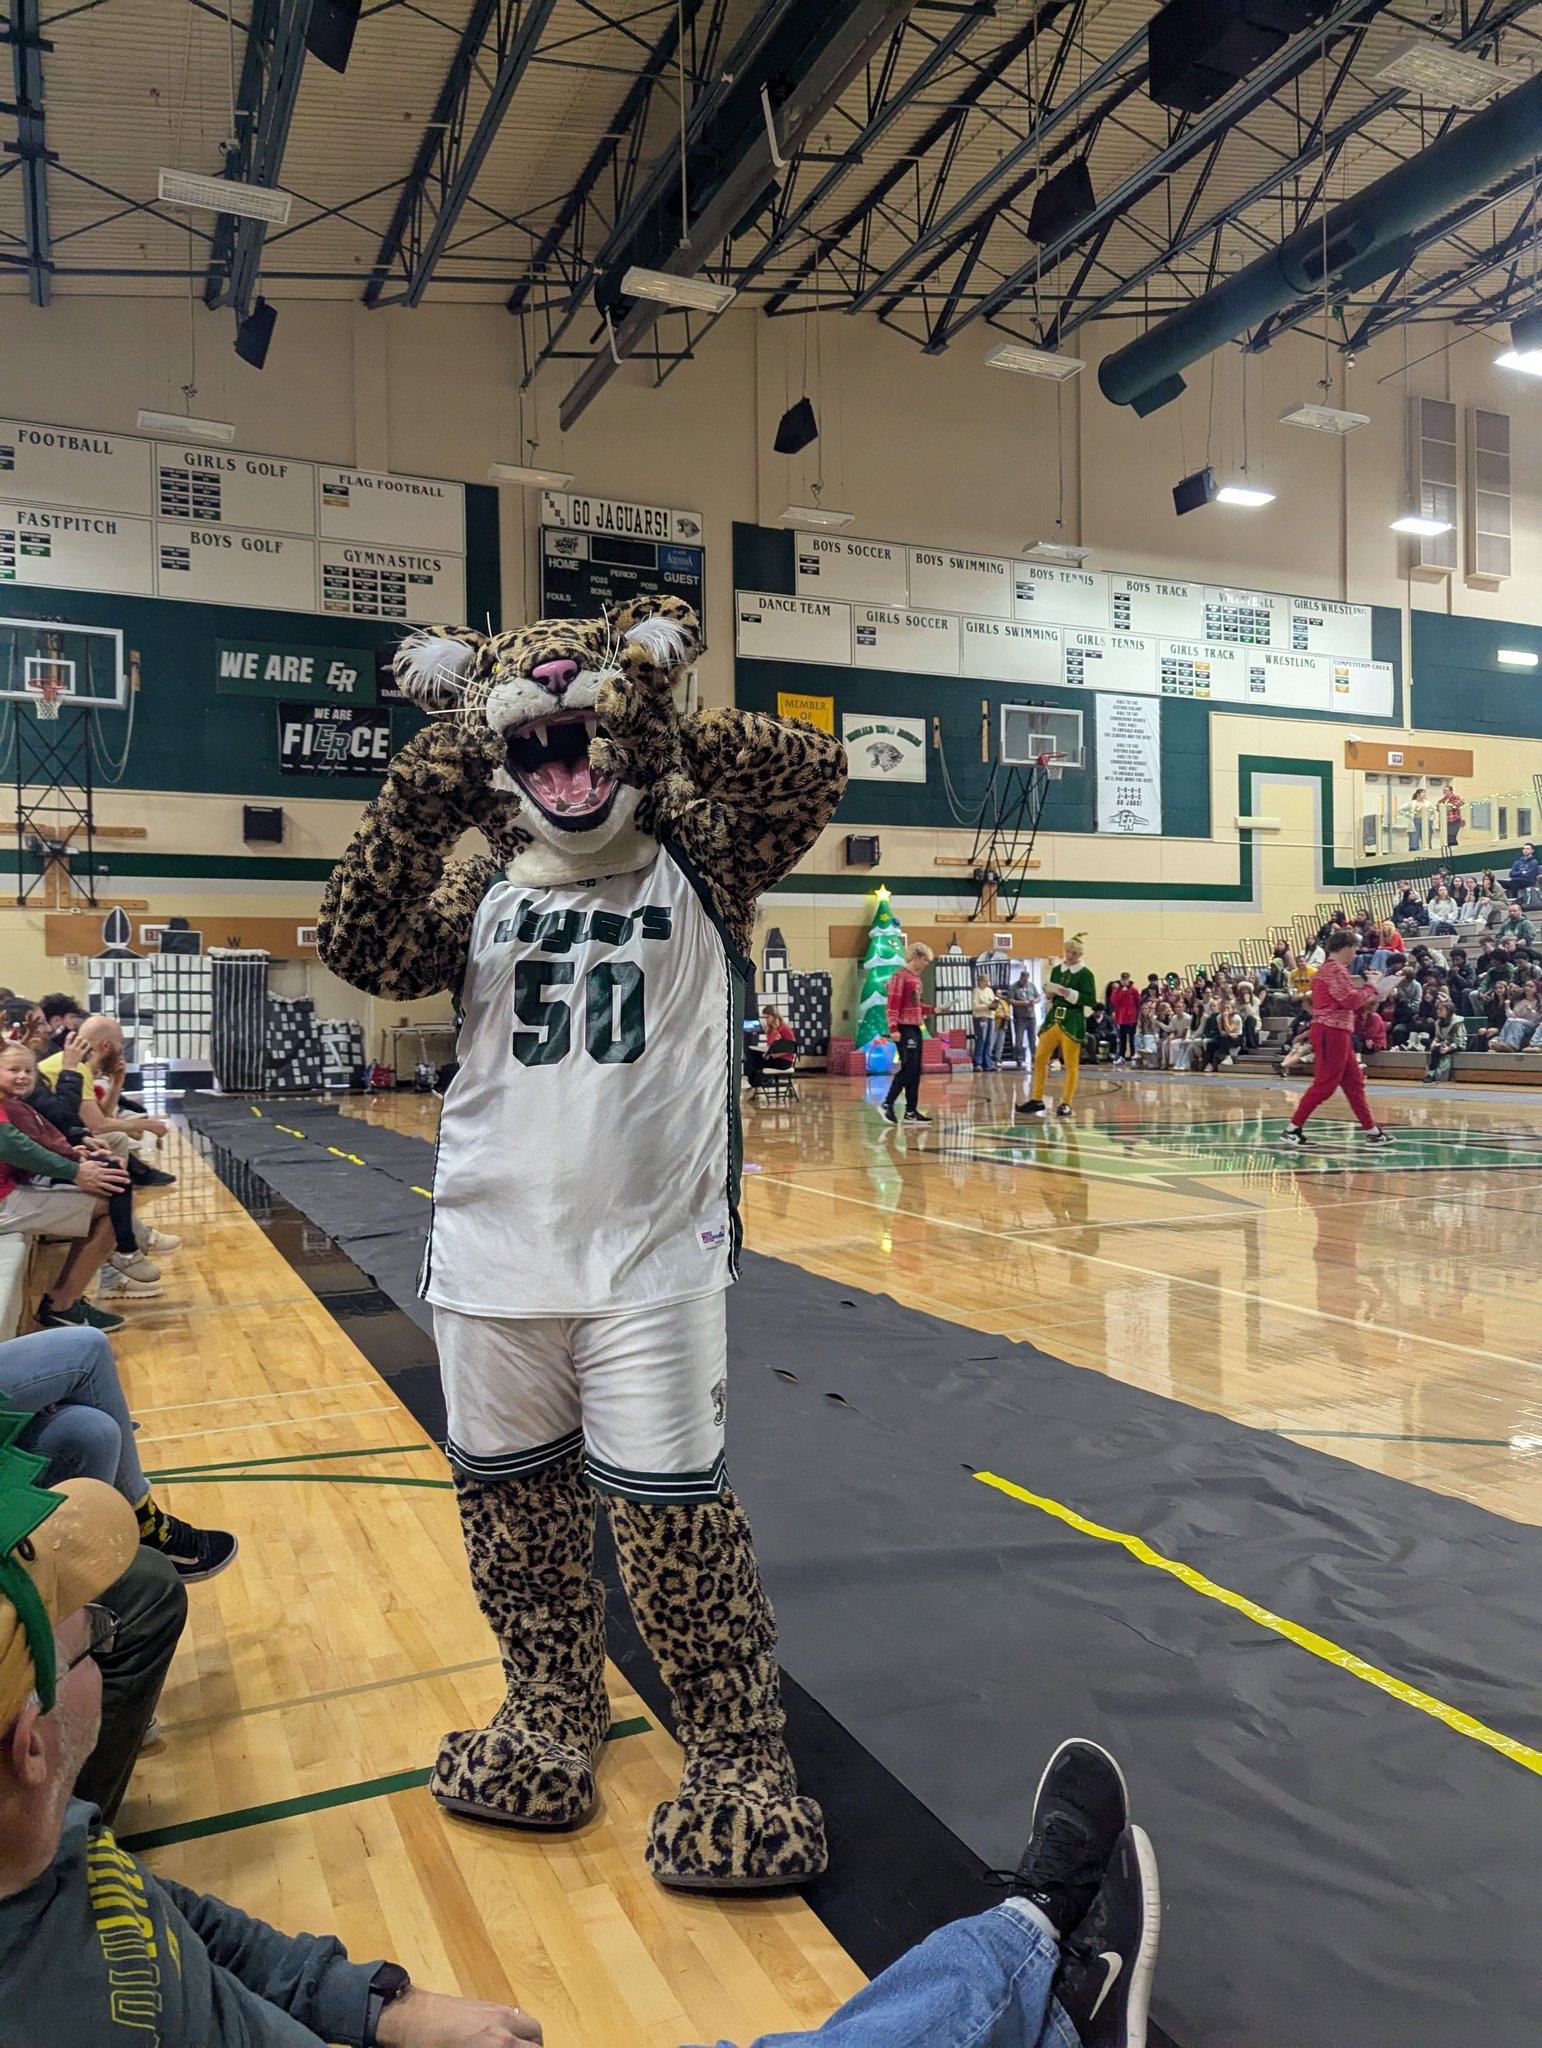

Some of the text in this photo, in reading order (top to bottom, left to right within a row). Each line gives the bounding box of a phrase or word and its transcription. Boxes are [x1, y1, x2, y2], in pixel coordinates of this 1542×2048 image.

[18, 429, 113, 455] FOOTBALL
[184, 452, 288, 478] GIRLS GOLF
[339, 474, 444, 497] FLAG FOOTBALL
[17, 511, 117, 535] FASTPITCH
[573, 499, 668, 538] GO JAGUARS!
[190, 531, 283, 554] BOYS GOLF
[813, 539, 892, 560] BOYS SOCCER
[343, 549, 442, 572] GYMNASTICS
[548, 558, 580, 571] HOME
[916, 553, 1004, 575] BOYS SWIMMING
[610, 569, 637, 579] PERIOD
[663, 572, 701, 586] GUEST
[1030, 568, 1054, 581] BOYS
[546, 592, 571, 602] FOULS
[1126, 580, 1188, 598] BOYS TRACK
[759, 597, 831, 616] DANCE TEAM
[1294, 598, 1320, 611] GIRLS
[866, 610, 948, 630] GIRLS SOCCER
[966, 621, 1058, 641] GIRLS SWIMMING
[1076, 633, 1145, 650] GIRLS TENNIS
[1170, 643, 1235, 660] GIRLS TRACK
[1265, 654, 1316, 669] WRESTLING
[220, 651, 358, 693] WE ARE ER
[784, 698, 827, 711] MEMBER
[314, 707, 353, 721] WE ARE
[800, 712, 813, 720] OF
[227, 936, 241, 947] W
[513, 960, 645, 1067] 50
